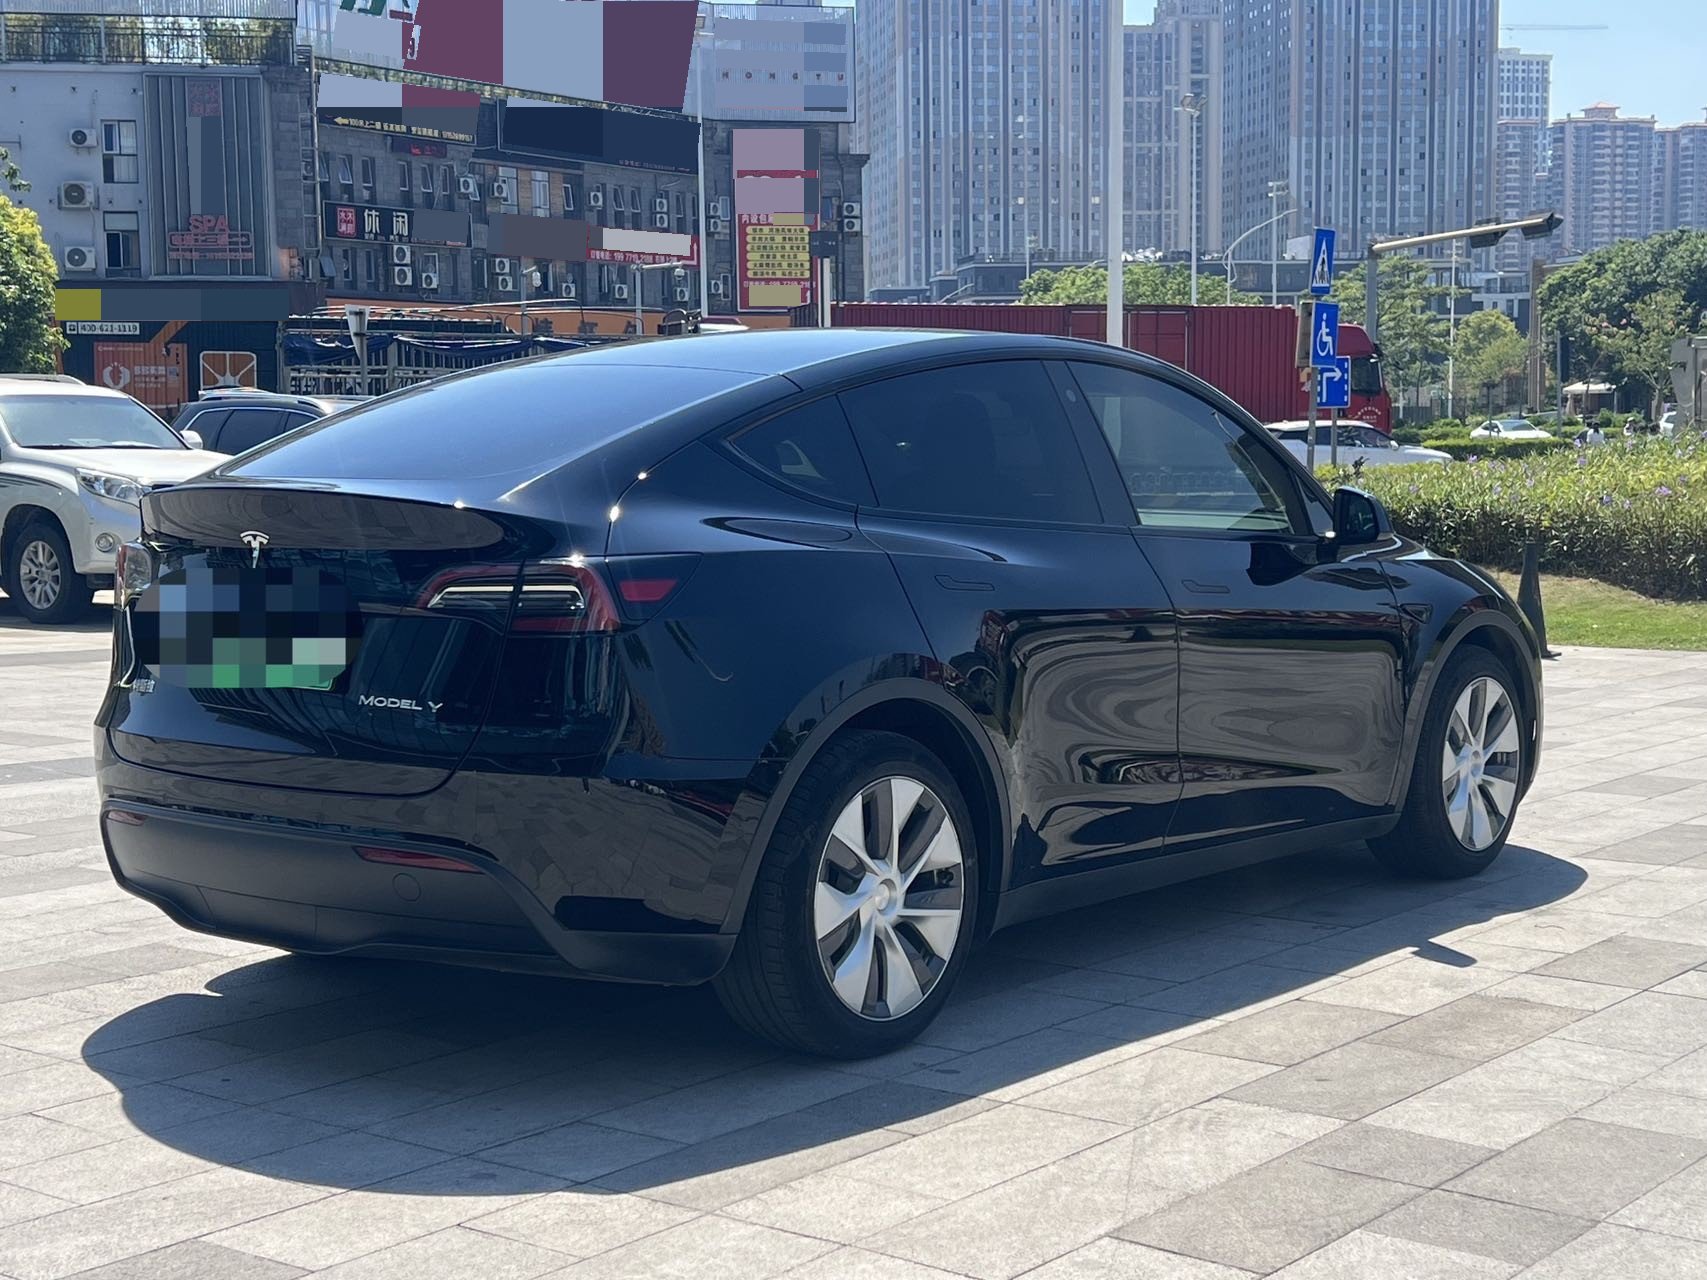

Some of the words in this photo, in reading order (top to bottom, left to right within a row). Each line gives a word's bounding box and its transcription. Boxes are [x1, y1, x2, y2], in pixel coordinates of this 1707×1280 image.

[189, 214, 229, 233] SPA
[364, 209, 408, 236] 休闲
[359, 694, 423, 710] MODEL
[427, 701, 443, 712] Y
